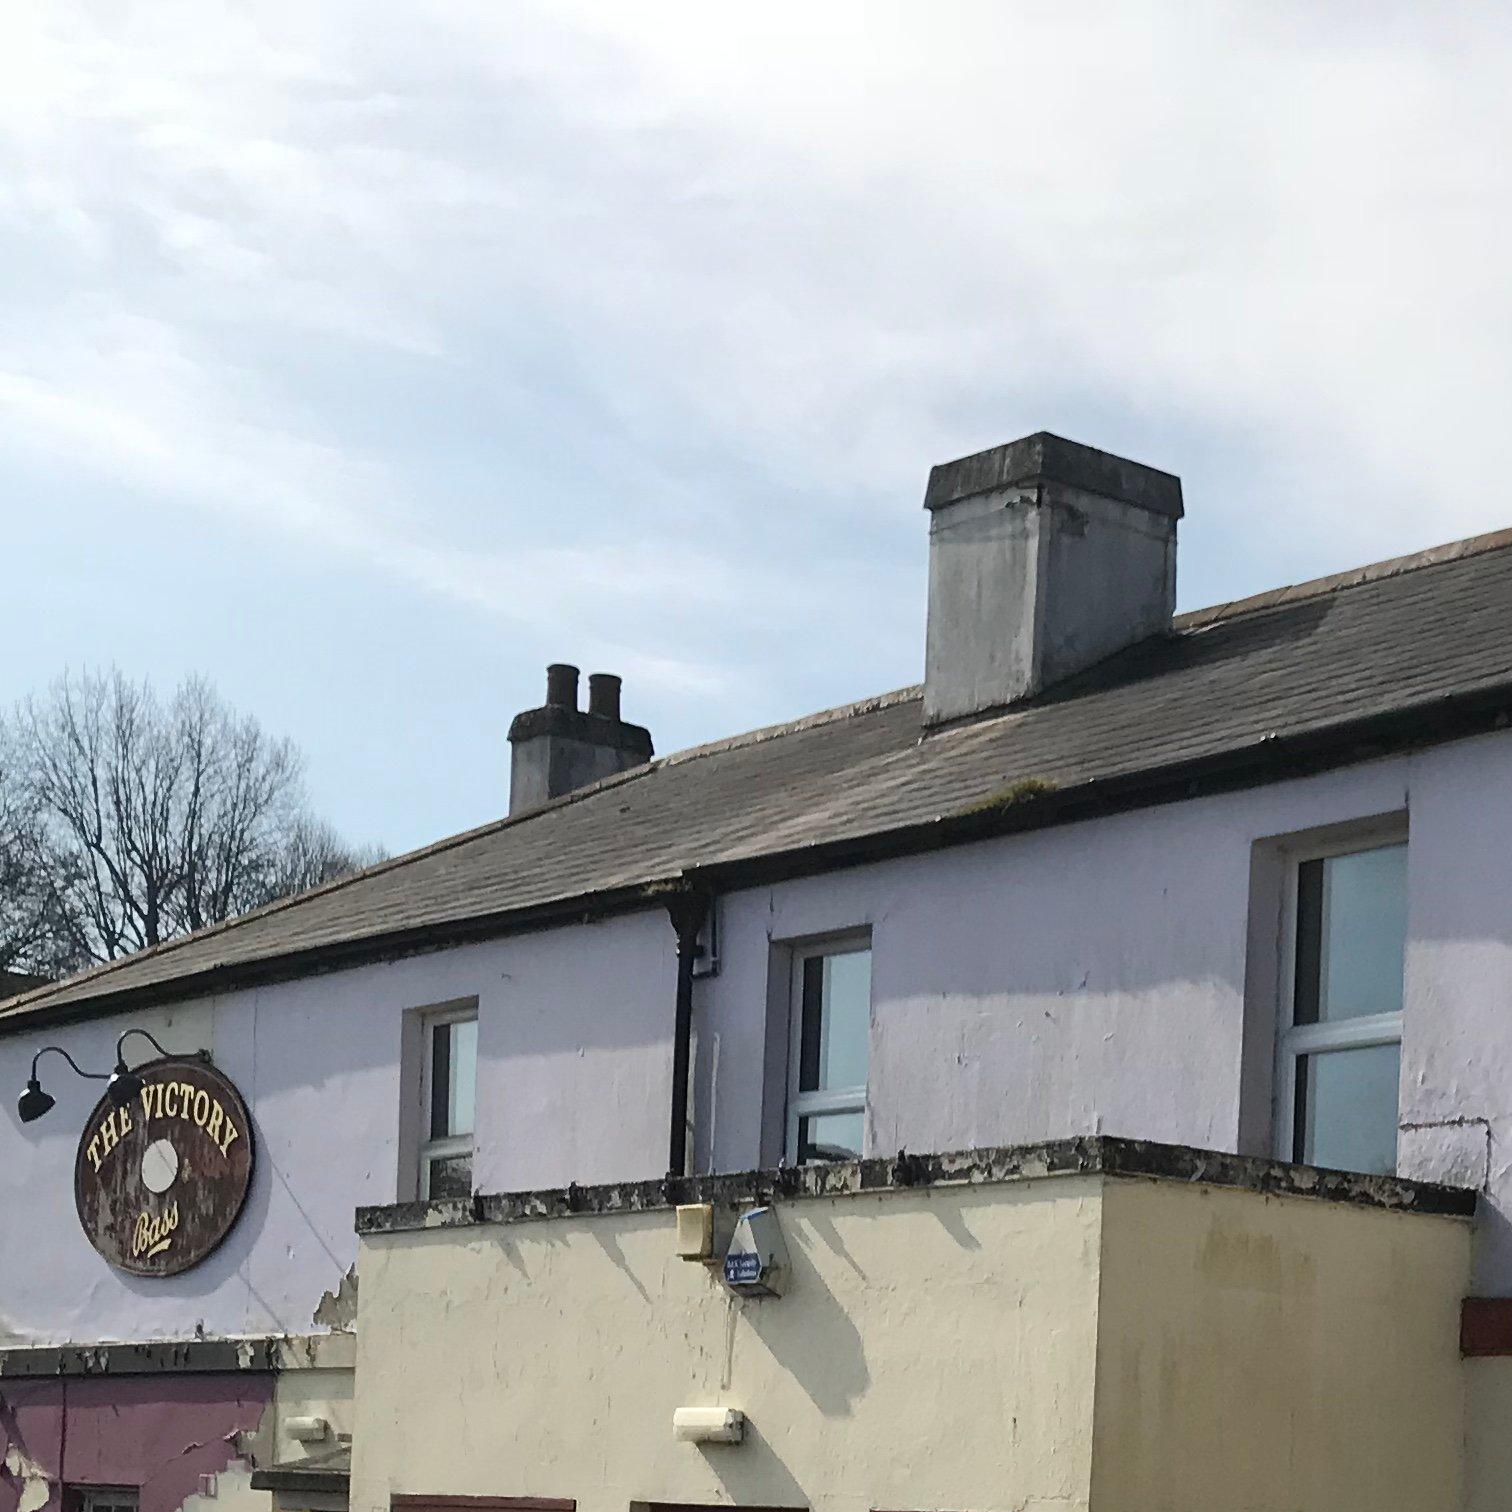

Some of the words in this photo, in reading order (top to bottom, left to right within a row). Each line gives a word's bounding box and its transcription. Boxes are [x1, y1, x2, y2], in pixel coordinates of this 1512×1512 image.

[86, 1102, 133, 1173] THE
[140, 1081, 239, 1159] VICTORY
[132, 1200, 180, 1257] Bass
